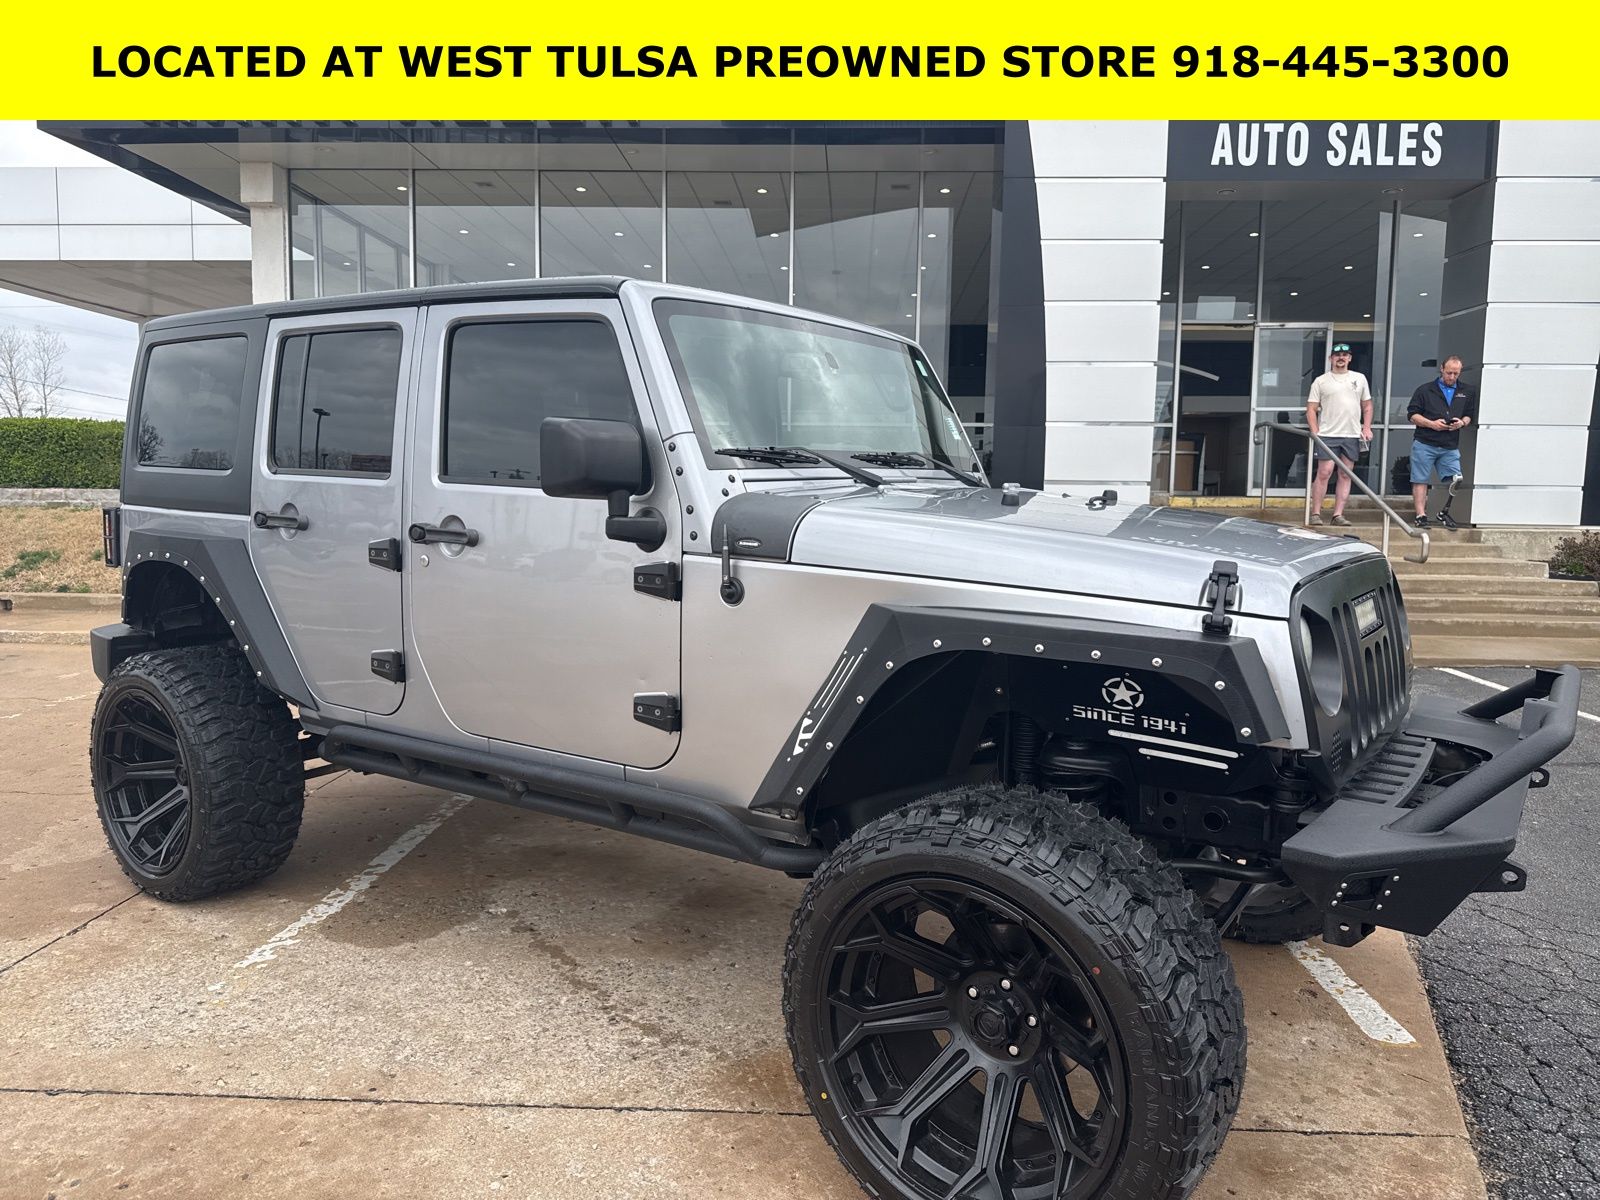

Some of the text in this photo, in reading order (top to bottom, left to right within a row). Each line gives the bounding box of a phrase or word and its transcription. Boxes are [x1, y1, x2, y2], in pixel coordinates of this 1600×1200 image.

[1210, 122, 1443, 167] AUTO SALES
[1141, 714, 1187, 735] 1941
